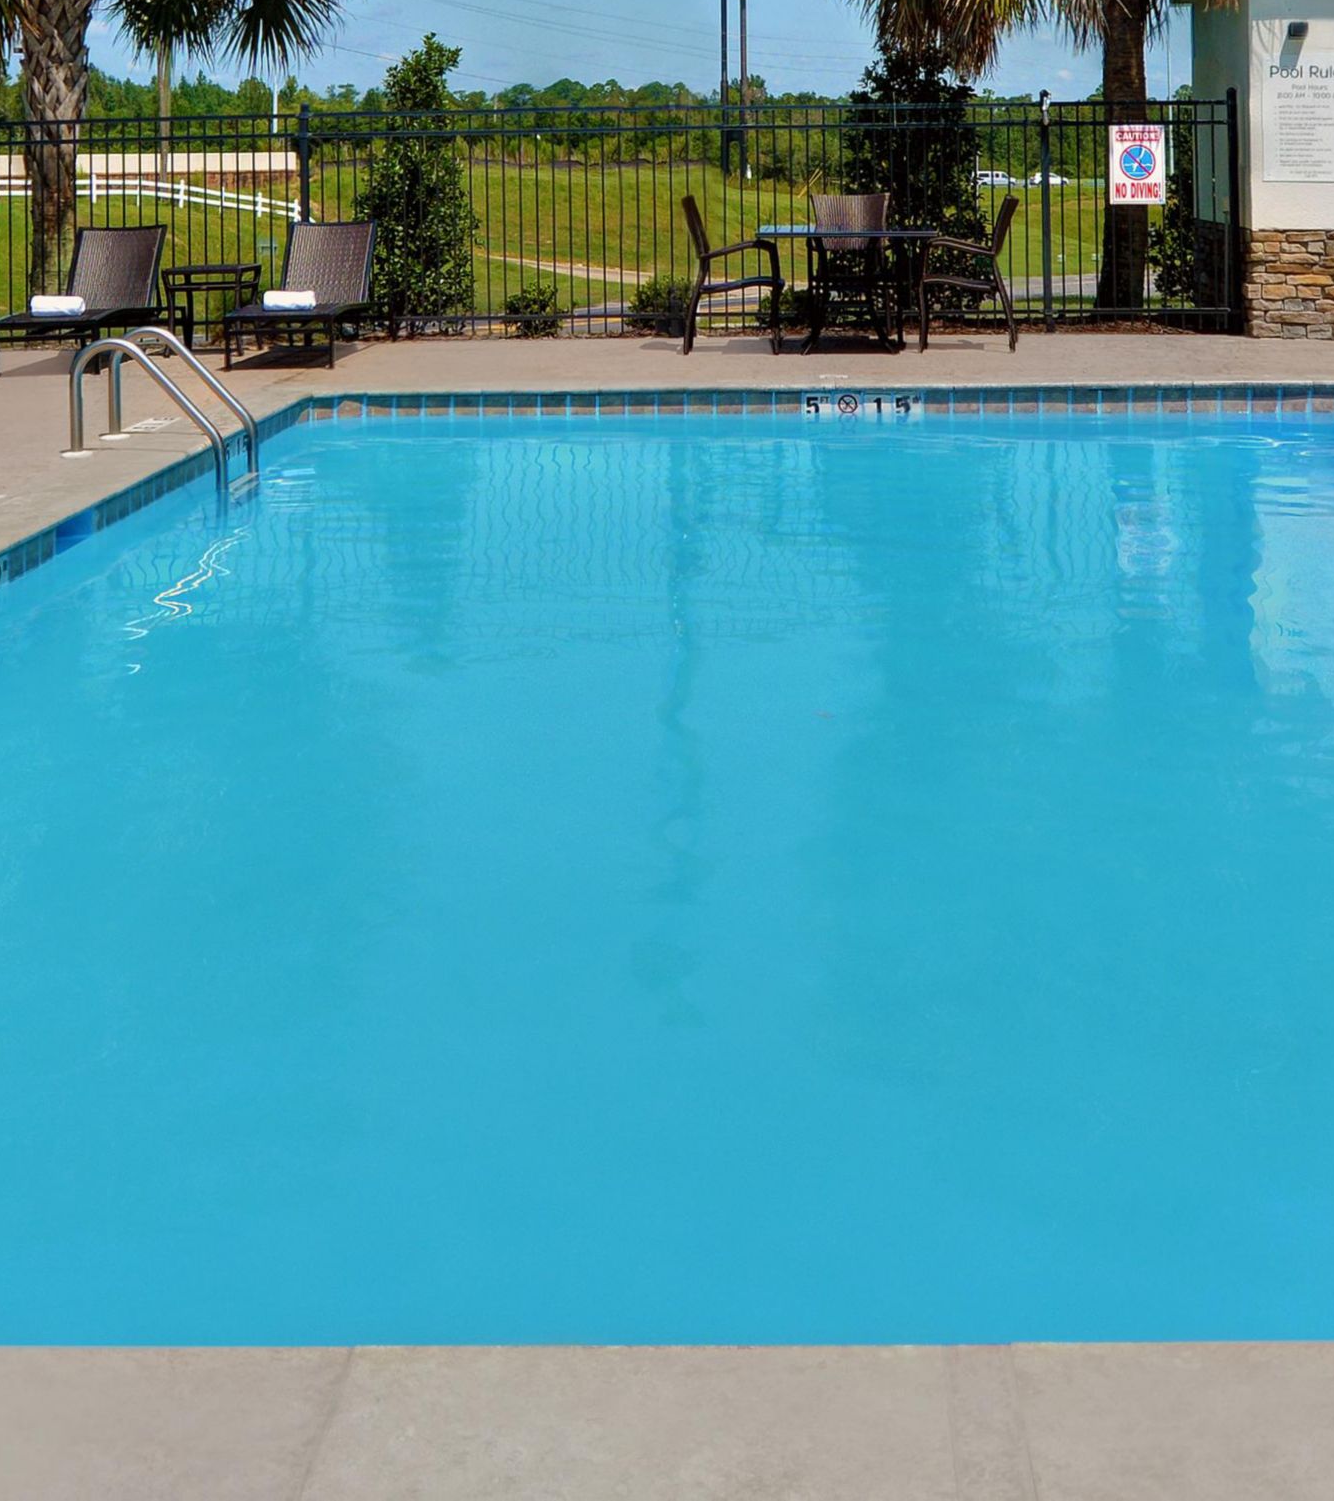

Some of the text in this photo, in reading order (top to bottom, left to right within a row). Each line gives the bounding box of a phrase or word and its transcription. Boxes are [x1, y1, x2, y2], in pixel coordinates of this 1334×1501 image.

[1269, 65, 1303, 79] Pool
[1115, 182, 1162, 199] NO DIVING!
